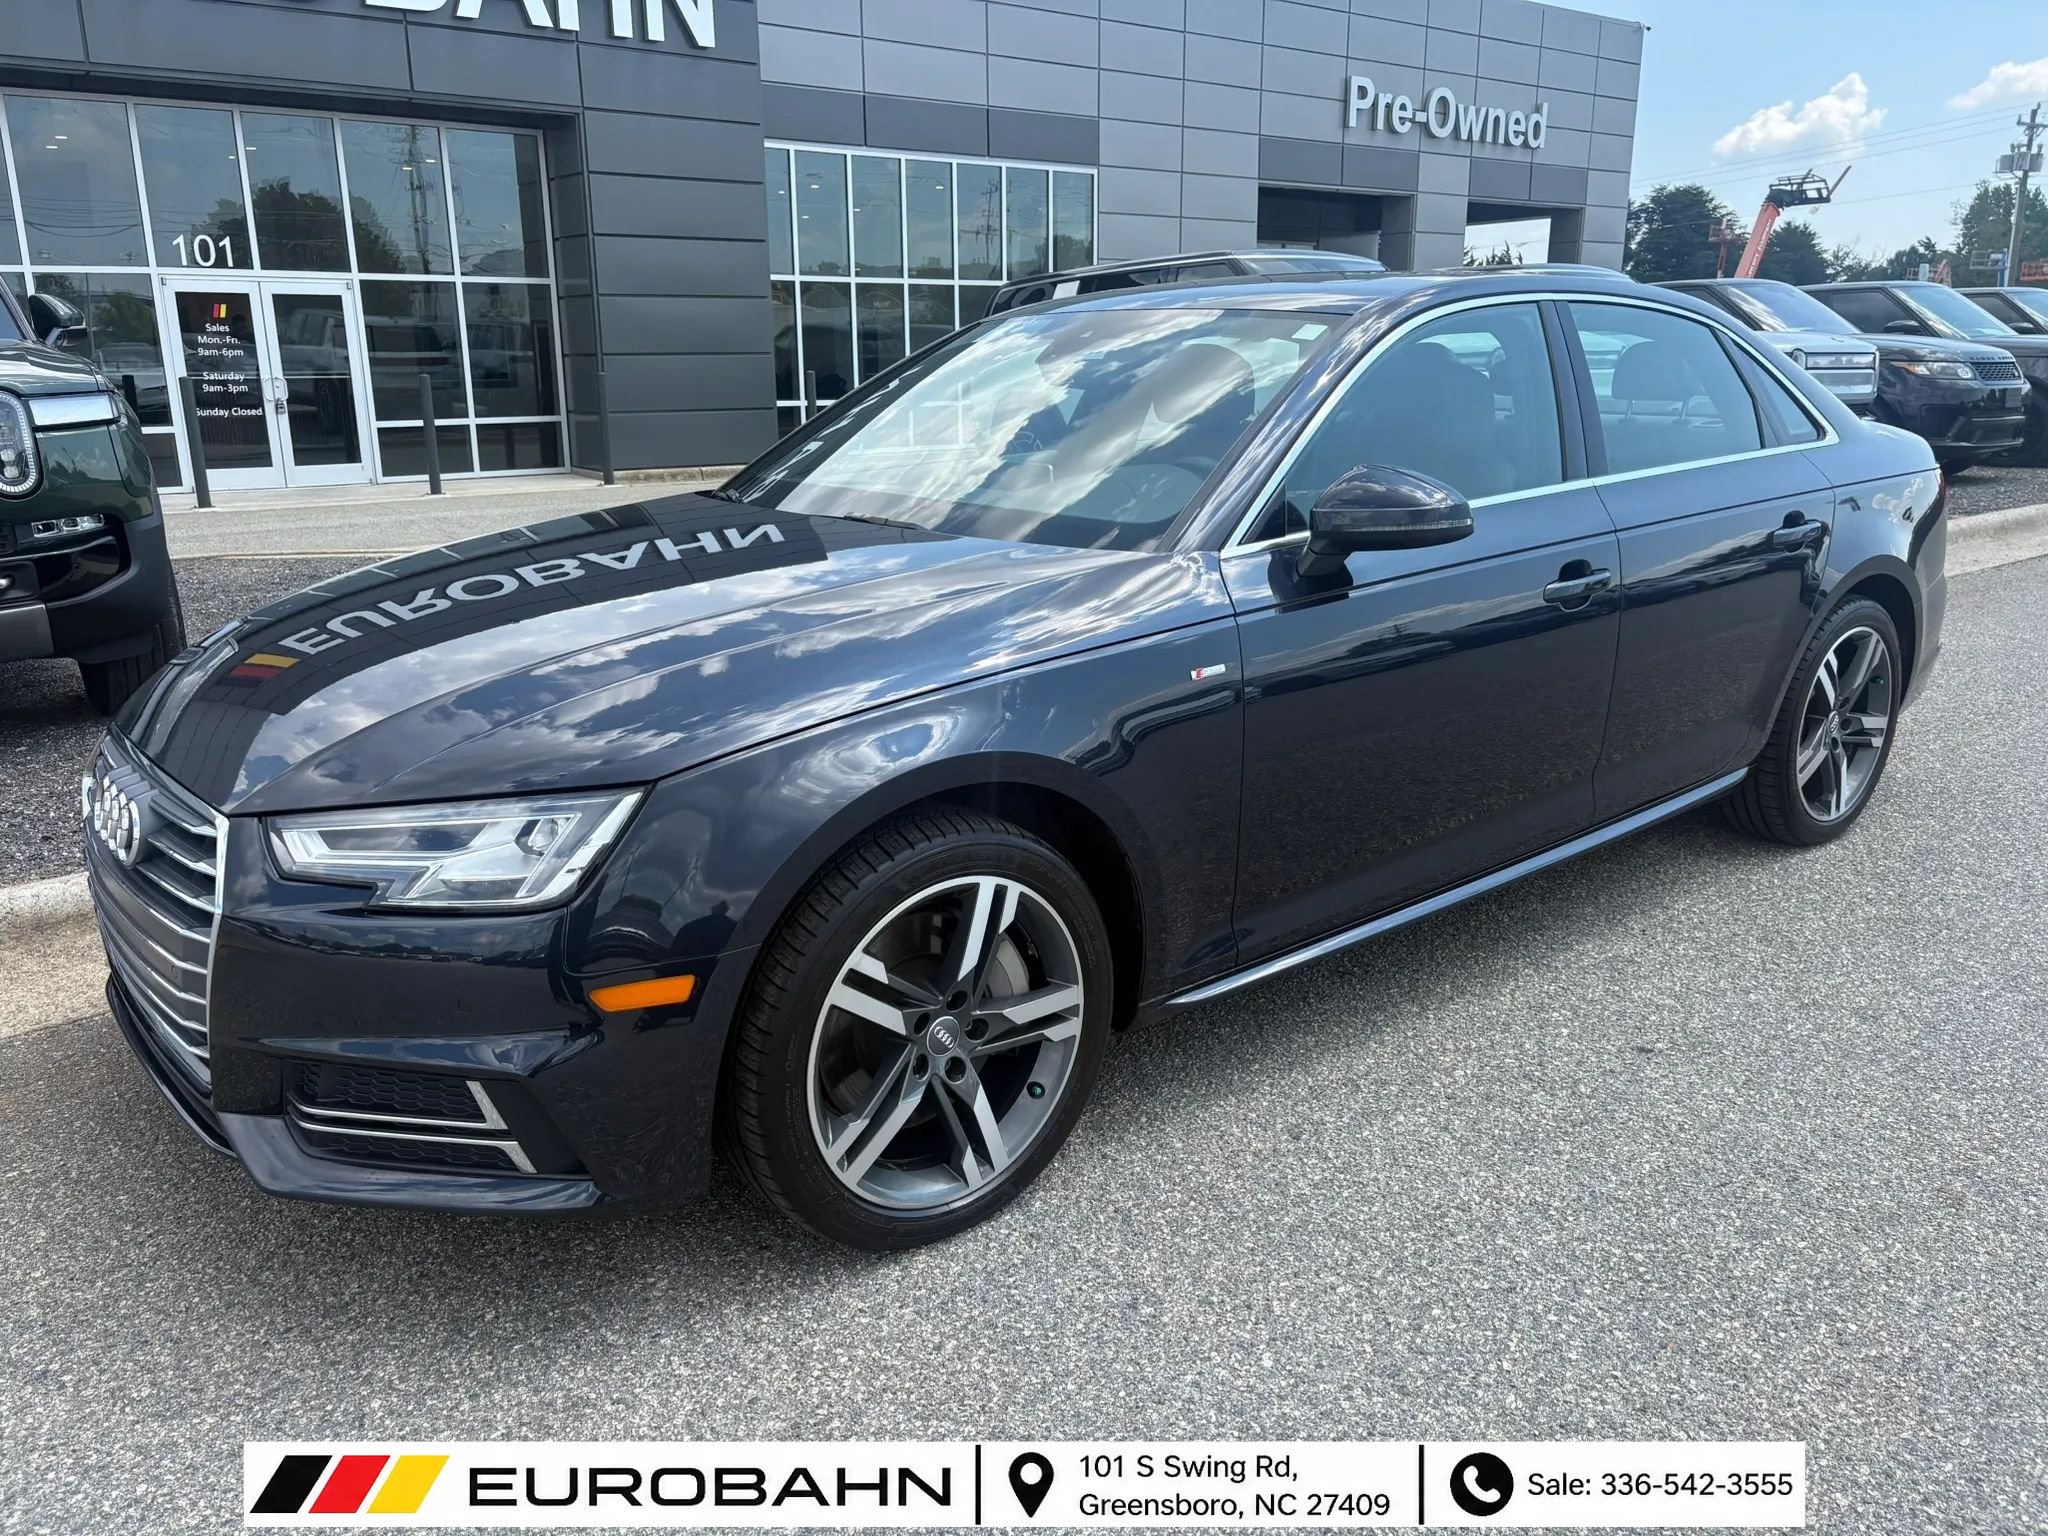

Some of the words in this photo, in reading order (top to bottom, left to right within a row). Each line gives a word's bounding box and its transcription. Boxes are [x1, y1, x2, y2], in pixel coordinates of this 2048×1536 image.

[1346, 75, 1549, 149] Pre-Owned
[172, 233, 234, 268] 101
[204, 323, 230, 333] Sales
[197, 347, 244, 358] 9am-6pm
[202, 371, 245, 382] Saturday
[202, 383, 249, 394] 9am-3pm
[231, 406, 263, 416] Closed
